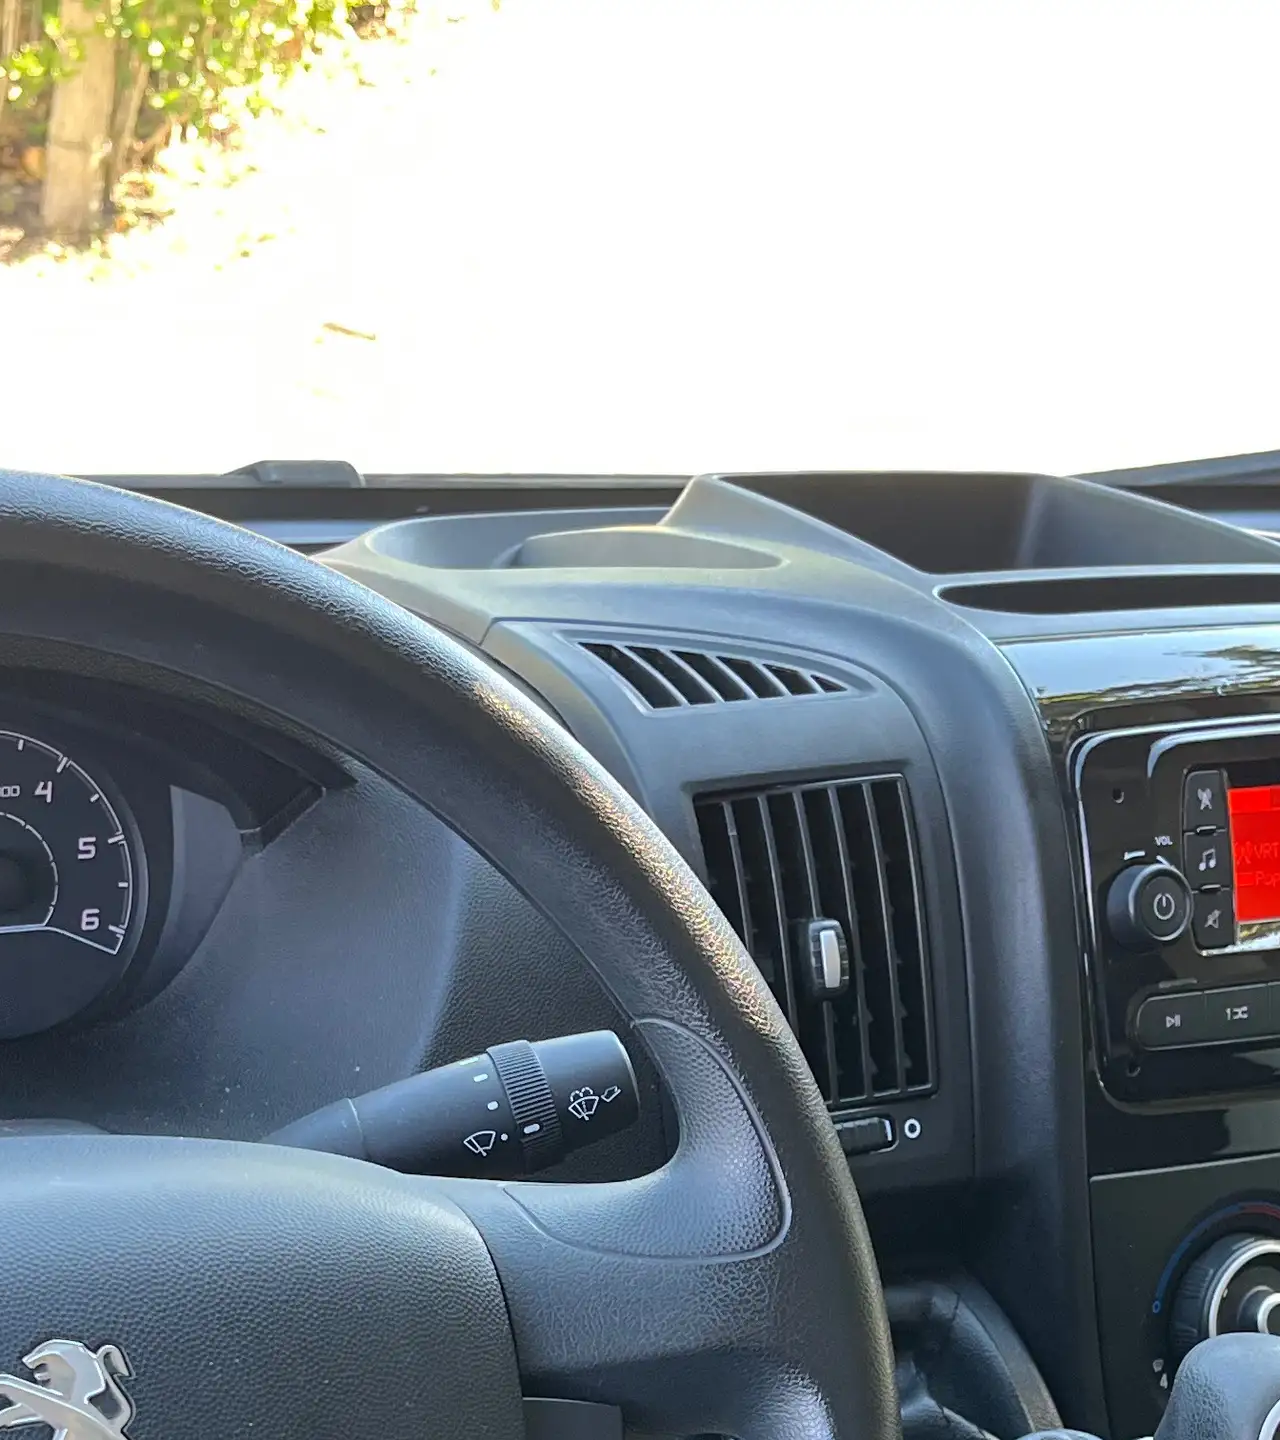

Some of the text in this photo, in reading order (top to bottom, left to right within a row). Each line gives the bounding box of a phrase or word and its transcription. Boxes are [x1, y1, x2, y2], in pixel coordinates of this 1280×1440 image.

[34, 780, 54, 804] 4
[78, 836, 97, 860] 5
[81, 907, 101, 932] 6
